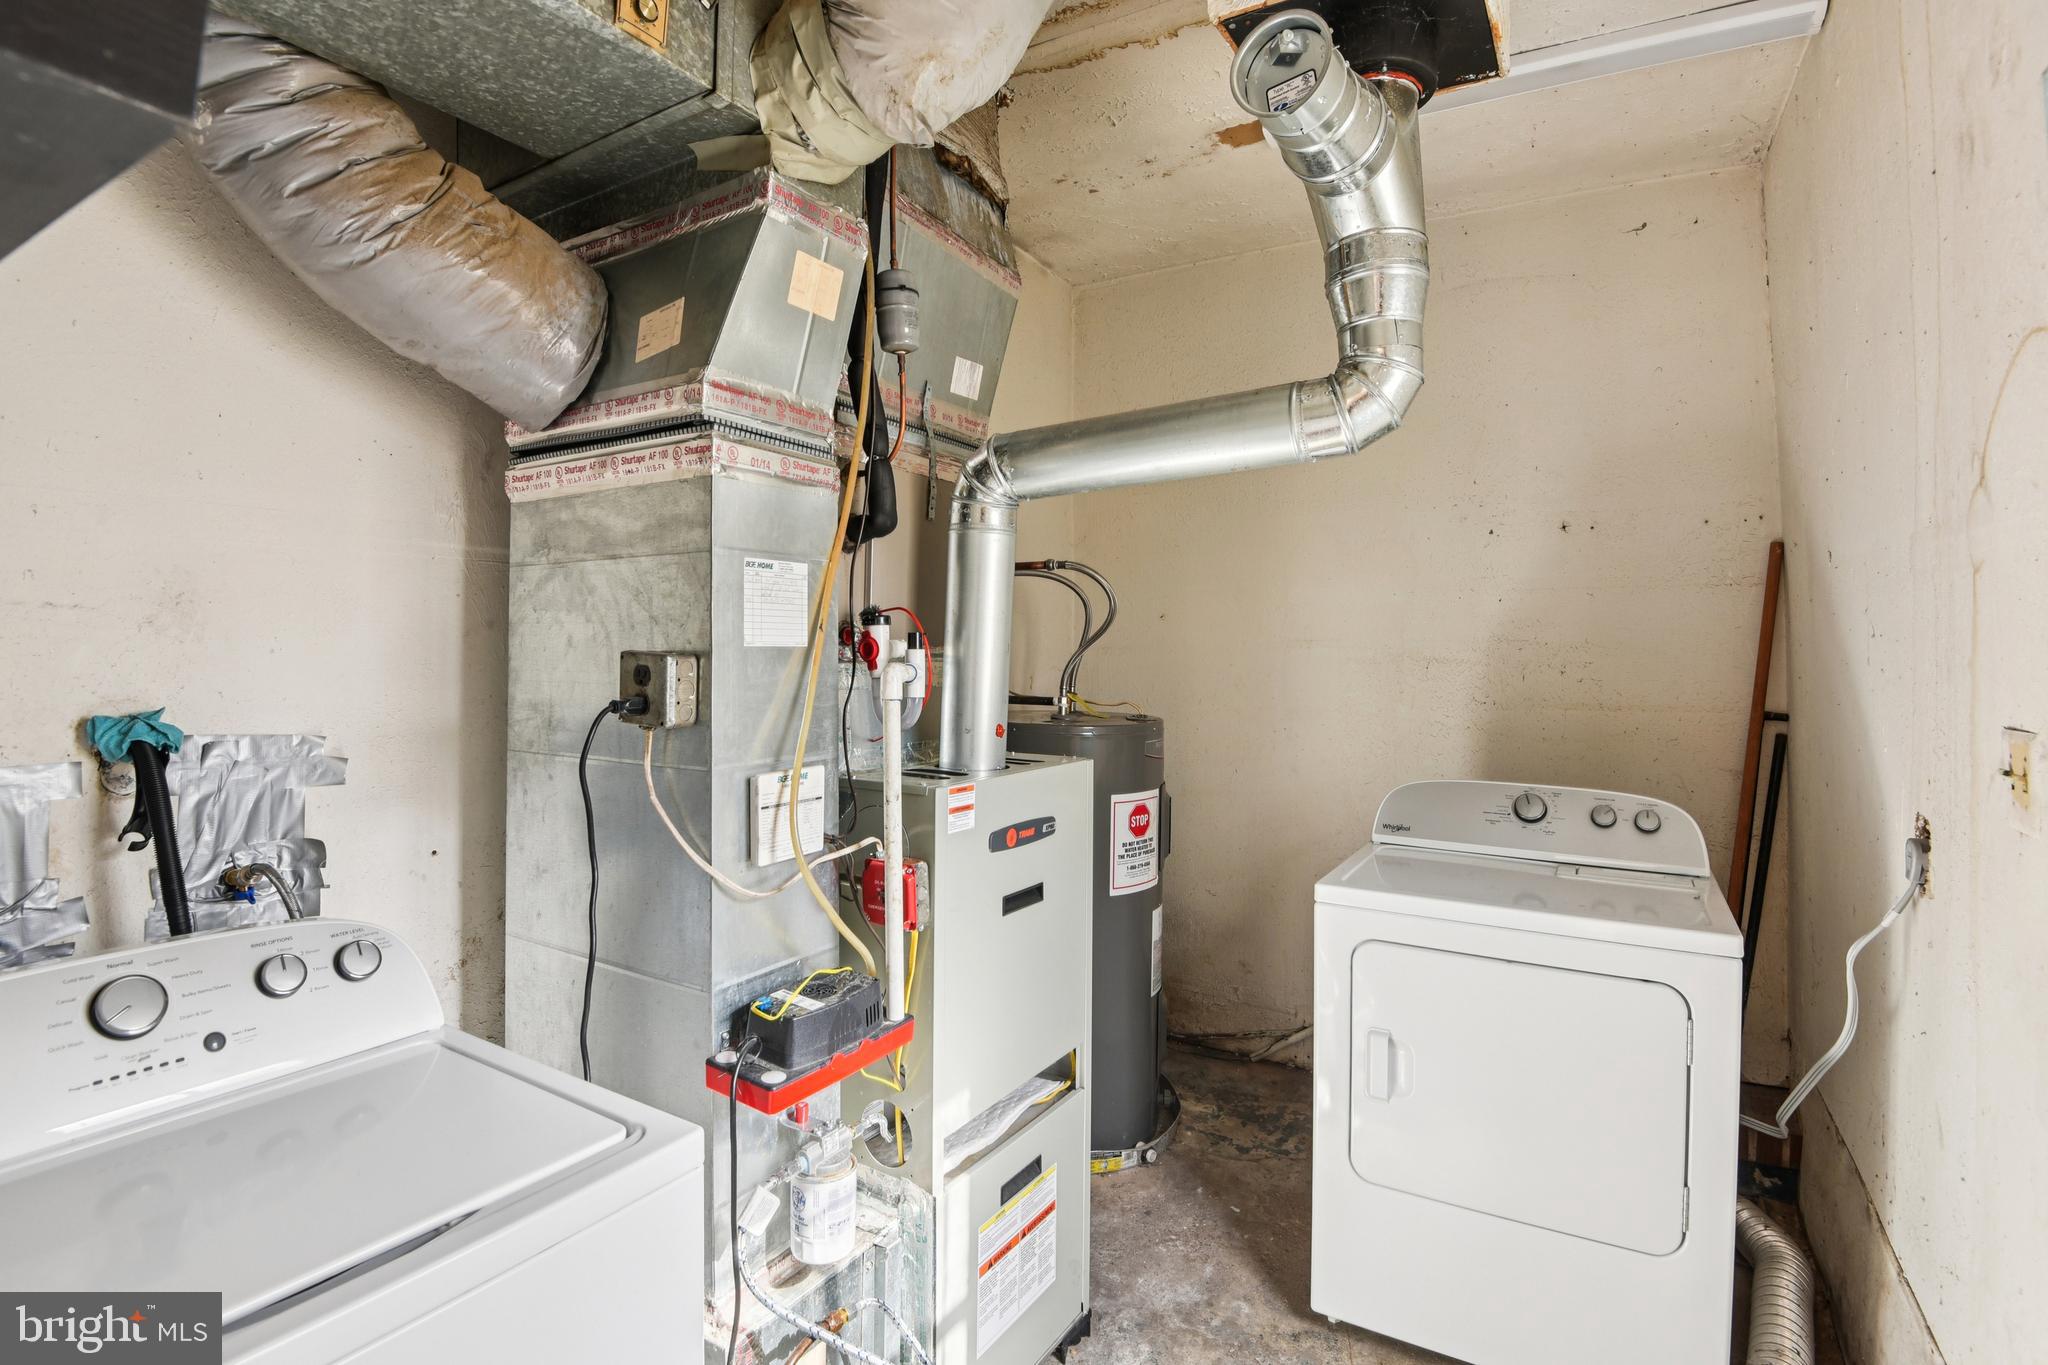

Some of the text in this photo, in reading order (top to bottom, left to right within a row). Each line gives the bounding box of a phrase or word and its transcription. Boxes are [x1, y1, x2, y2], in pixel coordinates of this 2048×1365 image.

[621, 449, 669, 467] Shurtape AF 100
[564, 459, 607, 476] Shurtape AF 100
[793, 462, 819, 475] Shurtape
[511, 469, 552, 485] Shurtape AF 100
[1131, 815, 1148, 827] STOP
[330, 927, 365, 939] WATER LEVEL
[250, 936, 294, 949] RINSE OPTIONS
[106, 959, 133, 969] Normal
